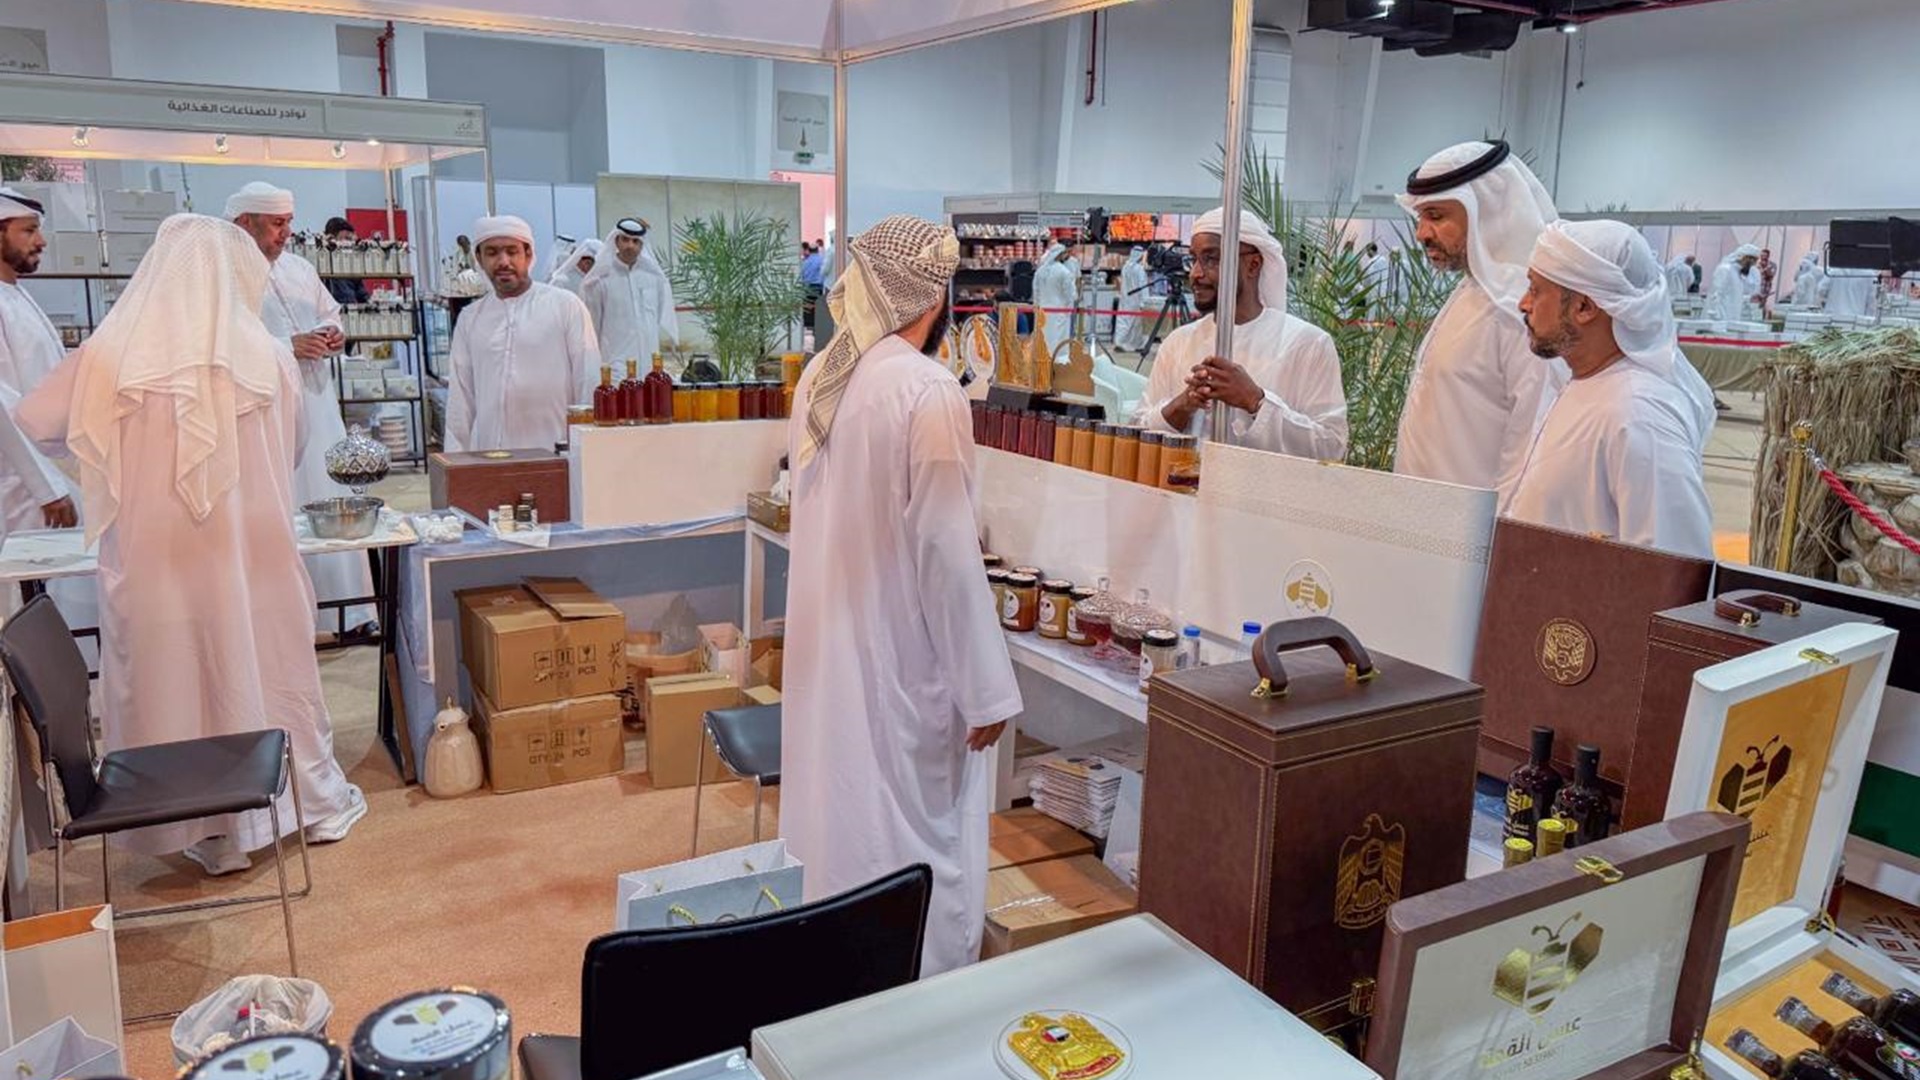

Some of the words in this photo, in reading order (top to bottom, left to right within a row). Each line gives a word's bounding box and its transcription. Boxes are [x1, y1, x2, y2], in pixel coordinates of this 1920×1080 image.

[167, 99, 217, 113] الغذائية
[219, 104, 277, 117] للصناعات
[279, 108, 306, 119] نوادر
[577, 665, 597, 675] PCS
[572, 747, 591, 758] PCS
